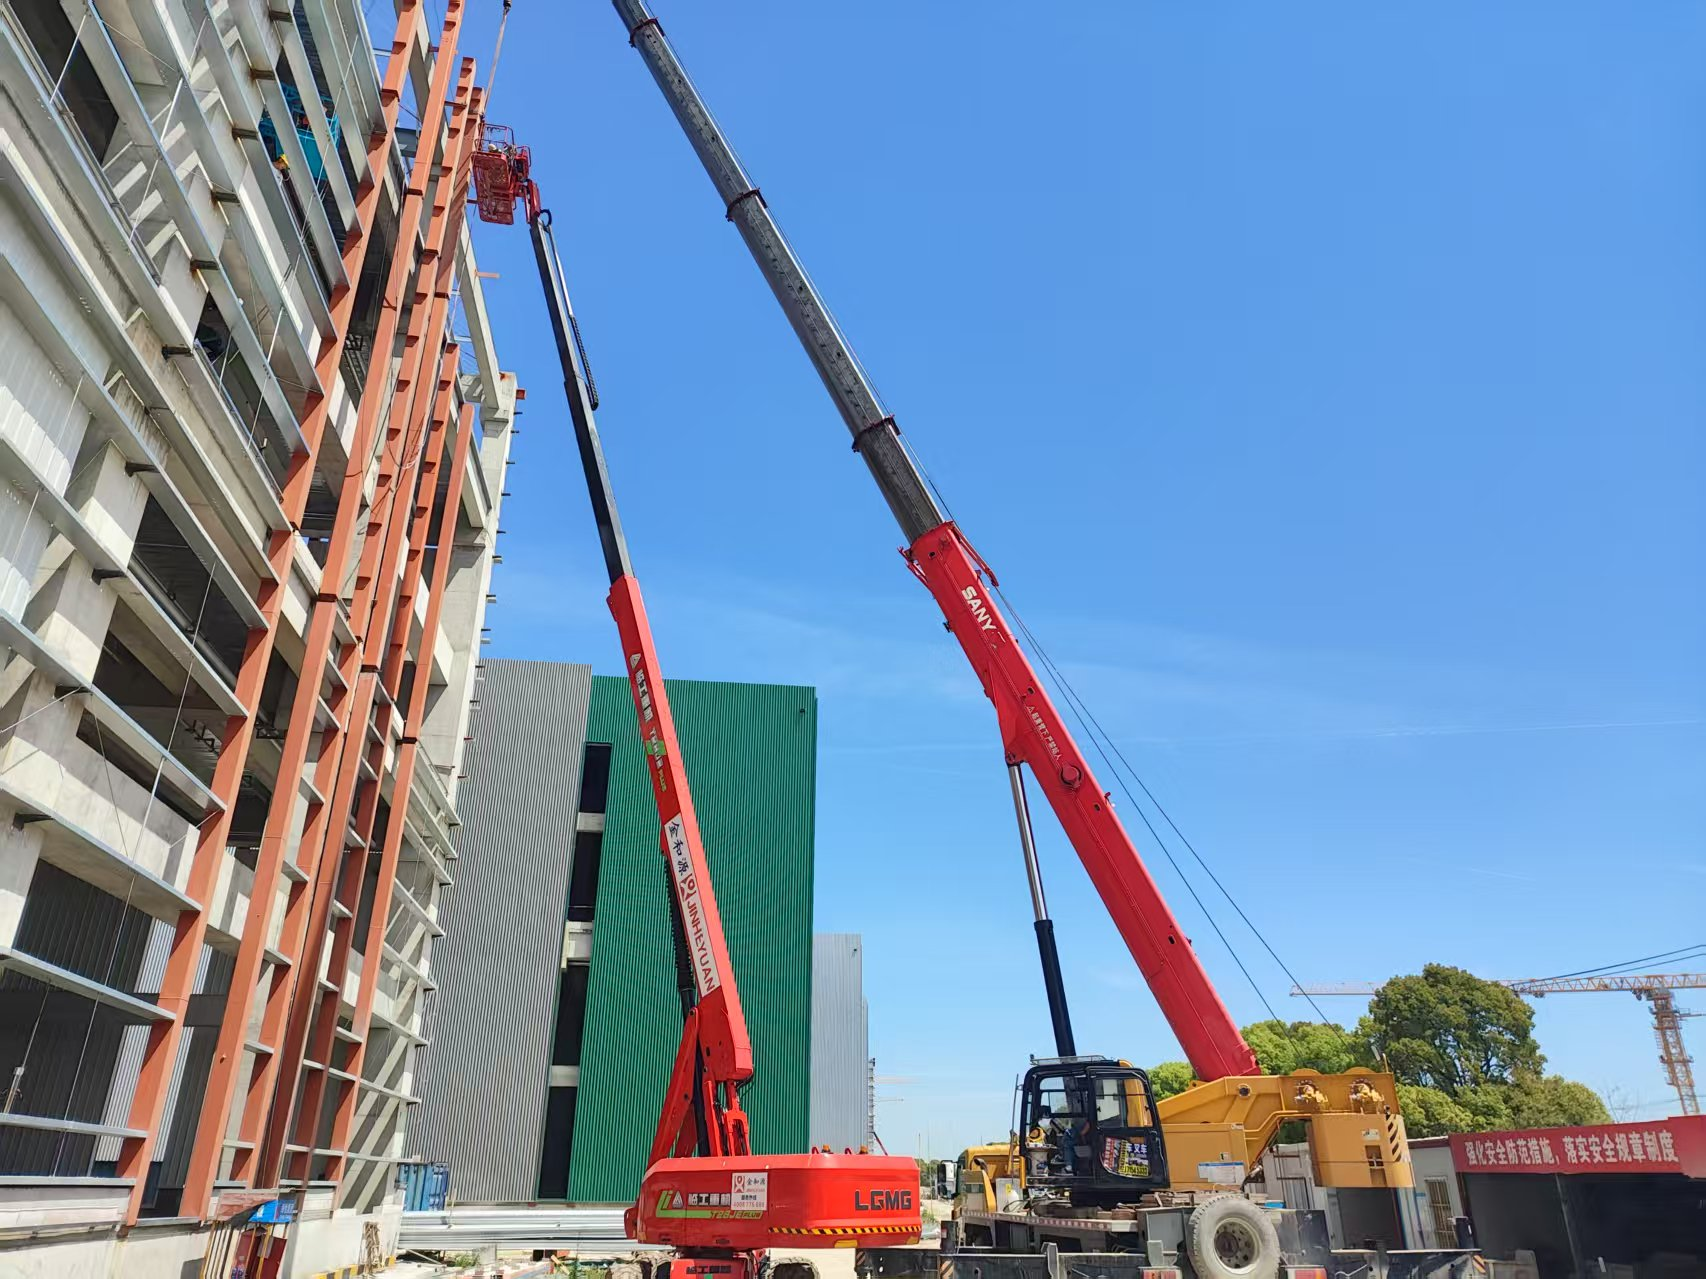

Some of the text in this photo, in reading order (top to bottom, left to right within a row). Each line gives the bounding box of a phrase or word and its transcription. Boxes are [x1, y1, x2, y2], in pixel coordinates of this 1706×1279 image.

[961, 586, 997, 631] SANY
[668, 821, 690, 877] 金和源
[687, 901, 714, 993] JINHEYUAN
[855, 1190, 912, 1210] LGMG
